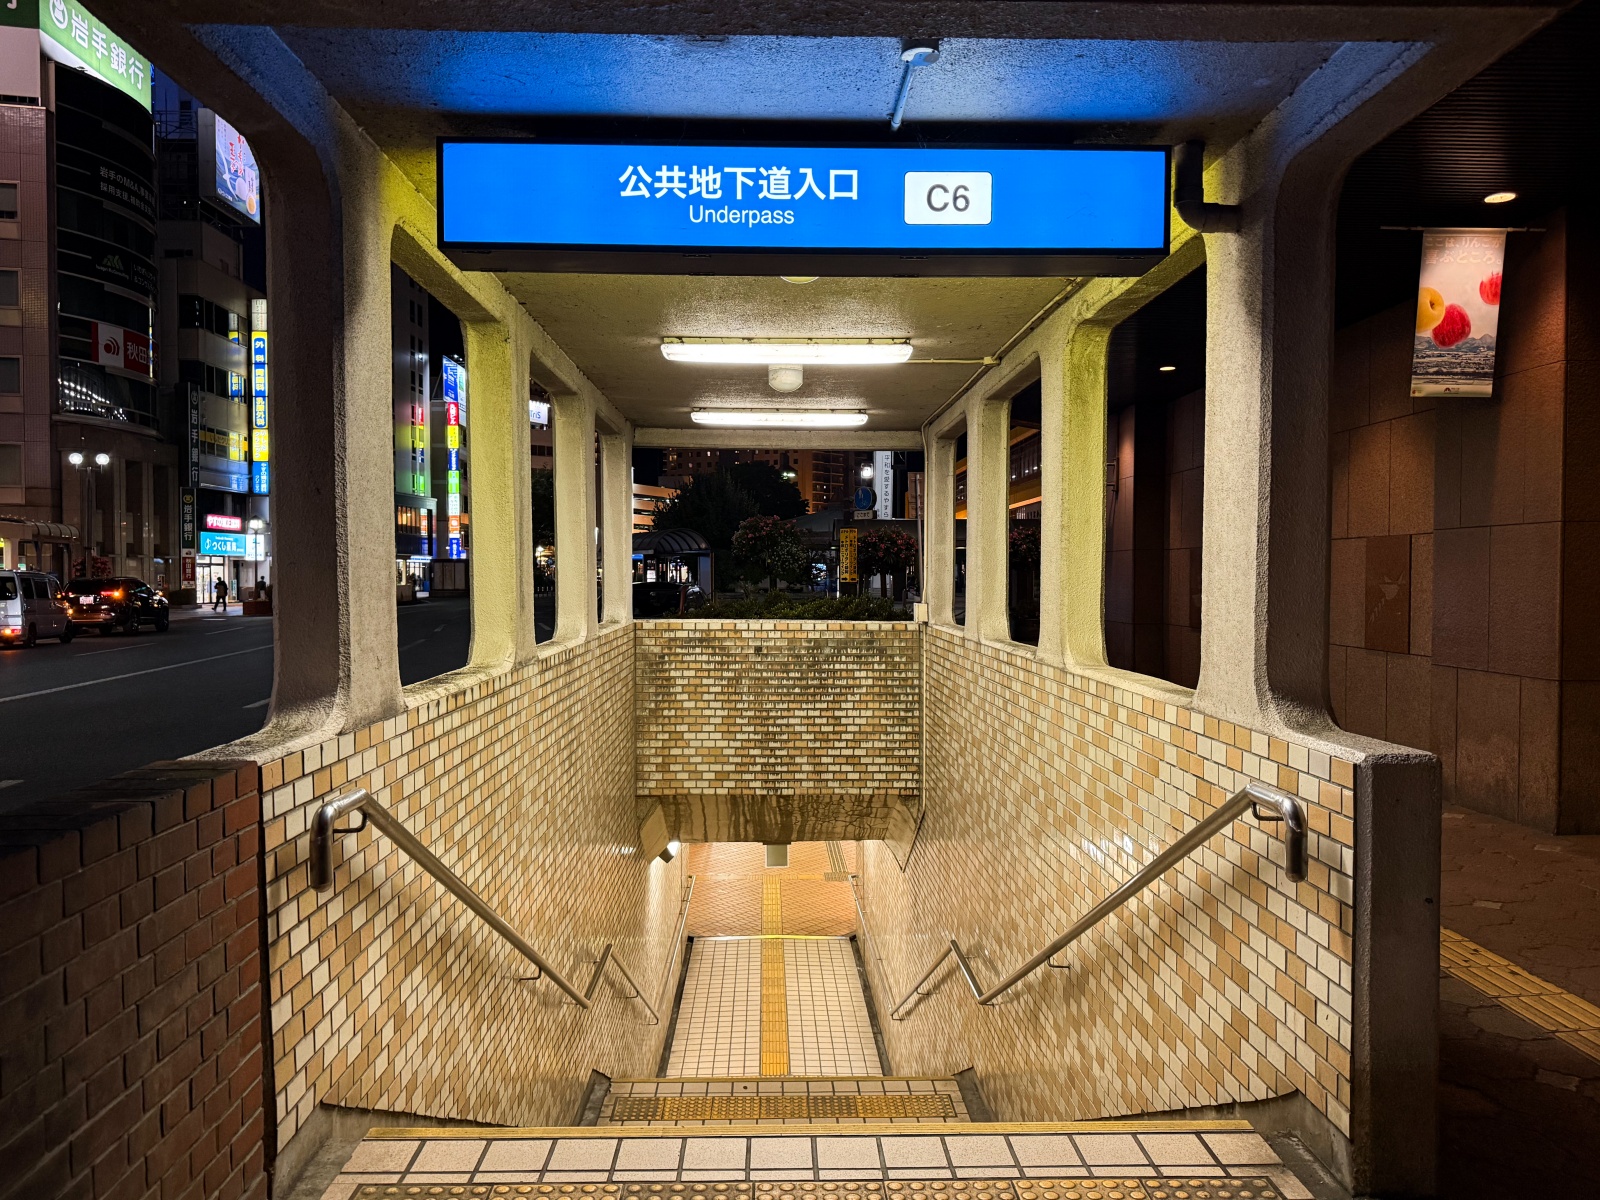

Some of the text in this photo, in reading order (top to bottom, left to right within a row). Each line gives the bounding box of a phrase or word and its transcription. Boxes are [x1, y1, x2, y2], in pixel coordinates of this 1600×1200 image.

[71, 8, 145, 90] 岩手銀行
[617, 165, 859, 202] 公共地下道入口
[925, 184, 970, 213] C6
[688, 205, 795, 226] Underpass
[1424, 249, 1502, 265] 喜ぶところ。
[183, 505, 193, 541] 岩手銀行
